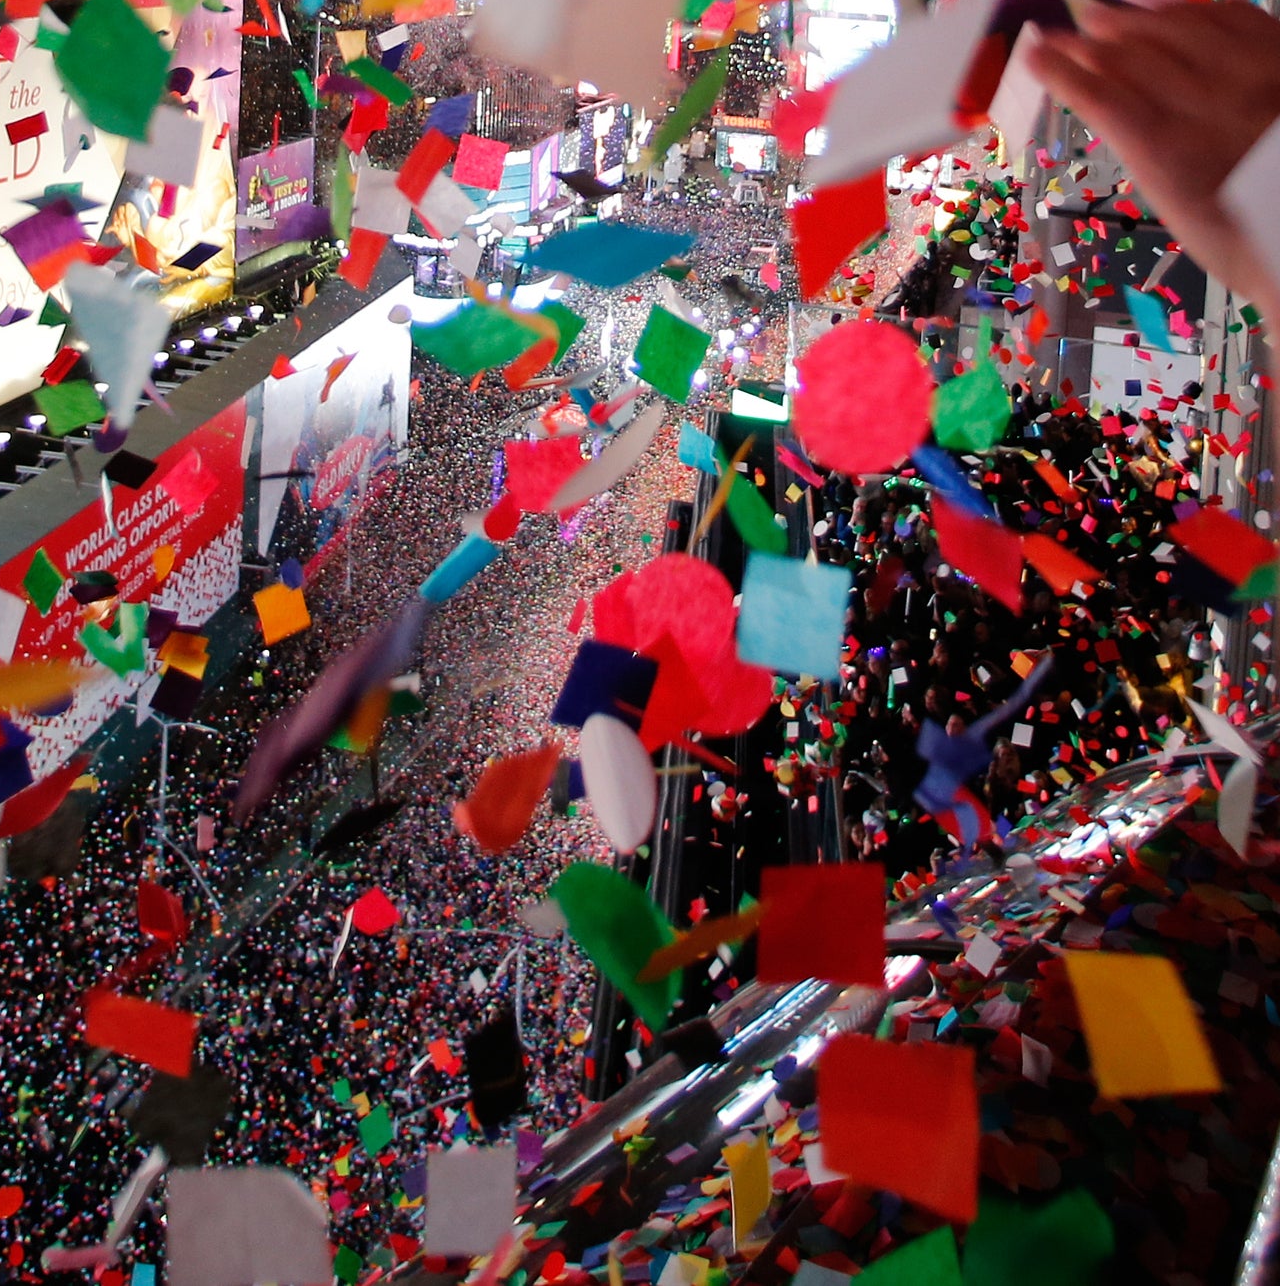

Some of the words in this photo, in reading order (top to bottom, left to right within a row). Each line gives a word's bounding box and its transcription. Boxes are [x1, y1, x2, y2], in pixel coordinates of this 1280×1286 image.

[10, 80, 41, 110] the
[65, 520, 113, 571] WORLD
[116, 490, 153, 532] CLASS
